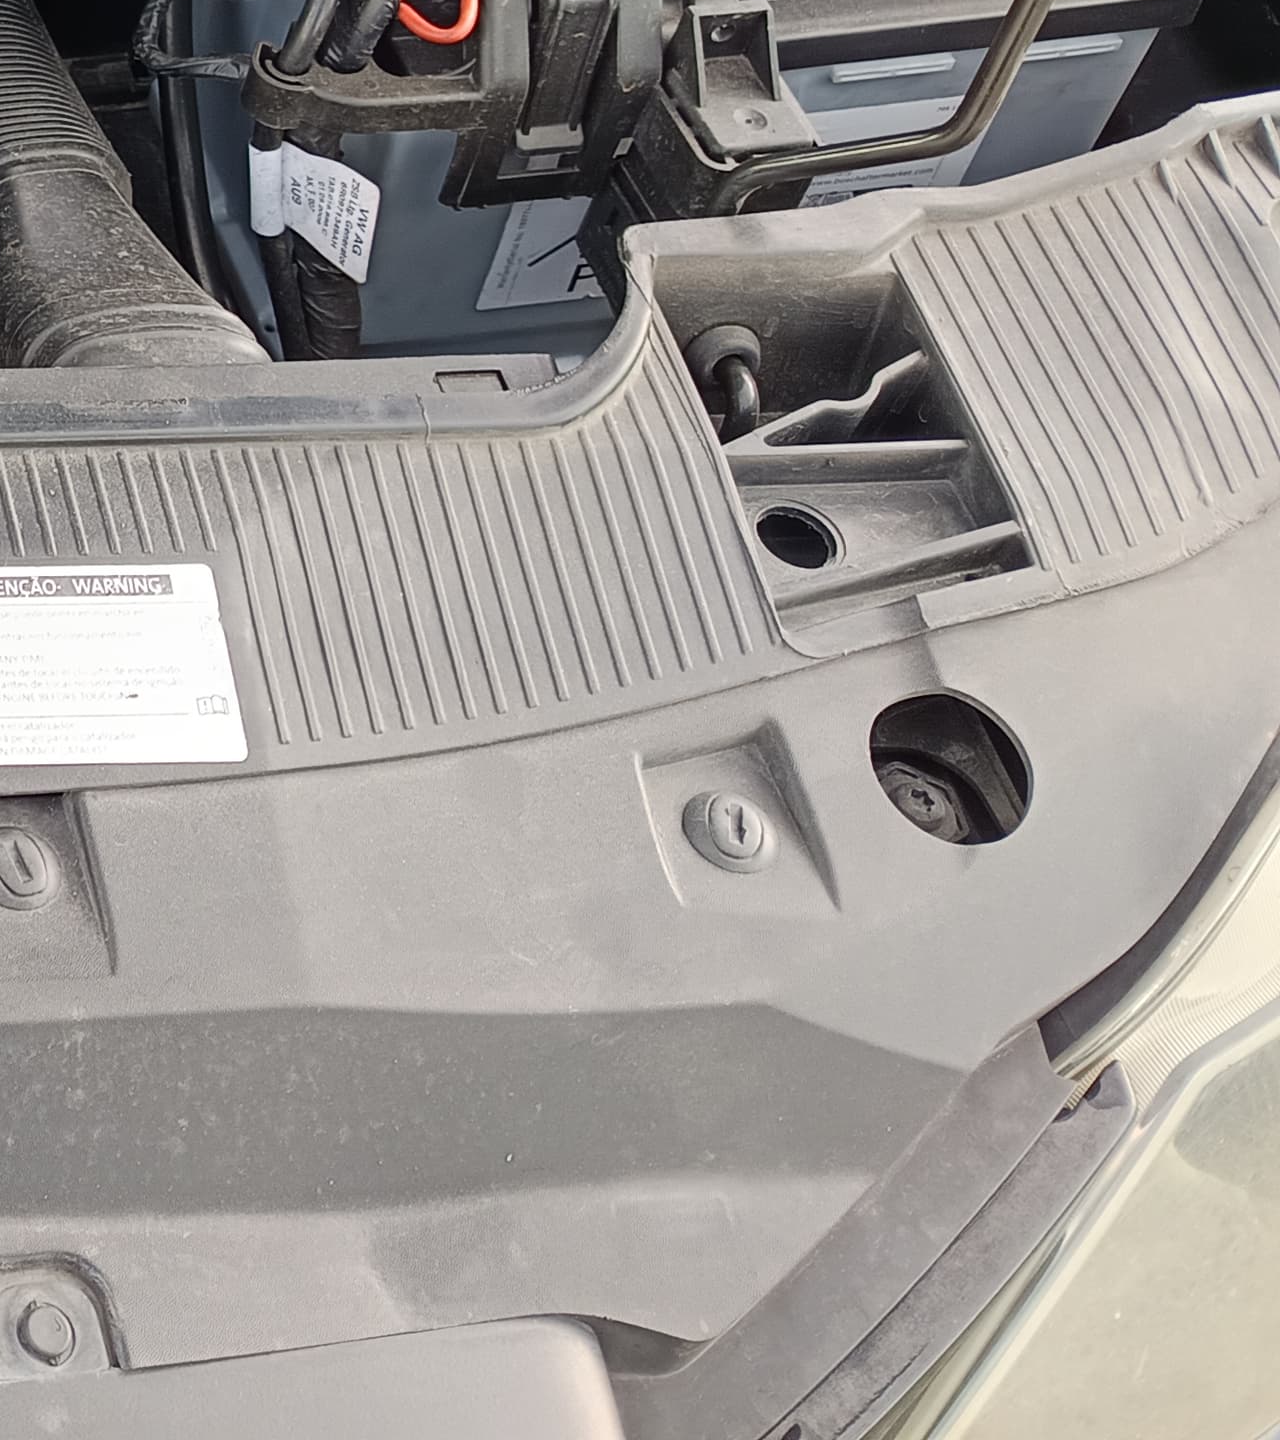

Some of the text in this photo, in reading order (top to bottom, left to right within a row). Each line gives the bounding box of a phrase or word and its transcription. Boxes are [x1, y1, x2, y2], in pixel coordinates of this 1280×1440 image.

[352, 208, 370, 257] VW AG
[72, 576, 162, 596] WARNING
